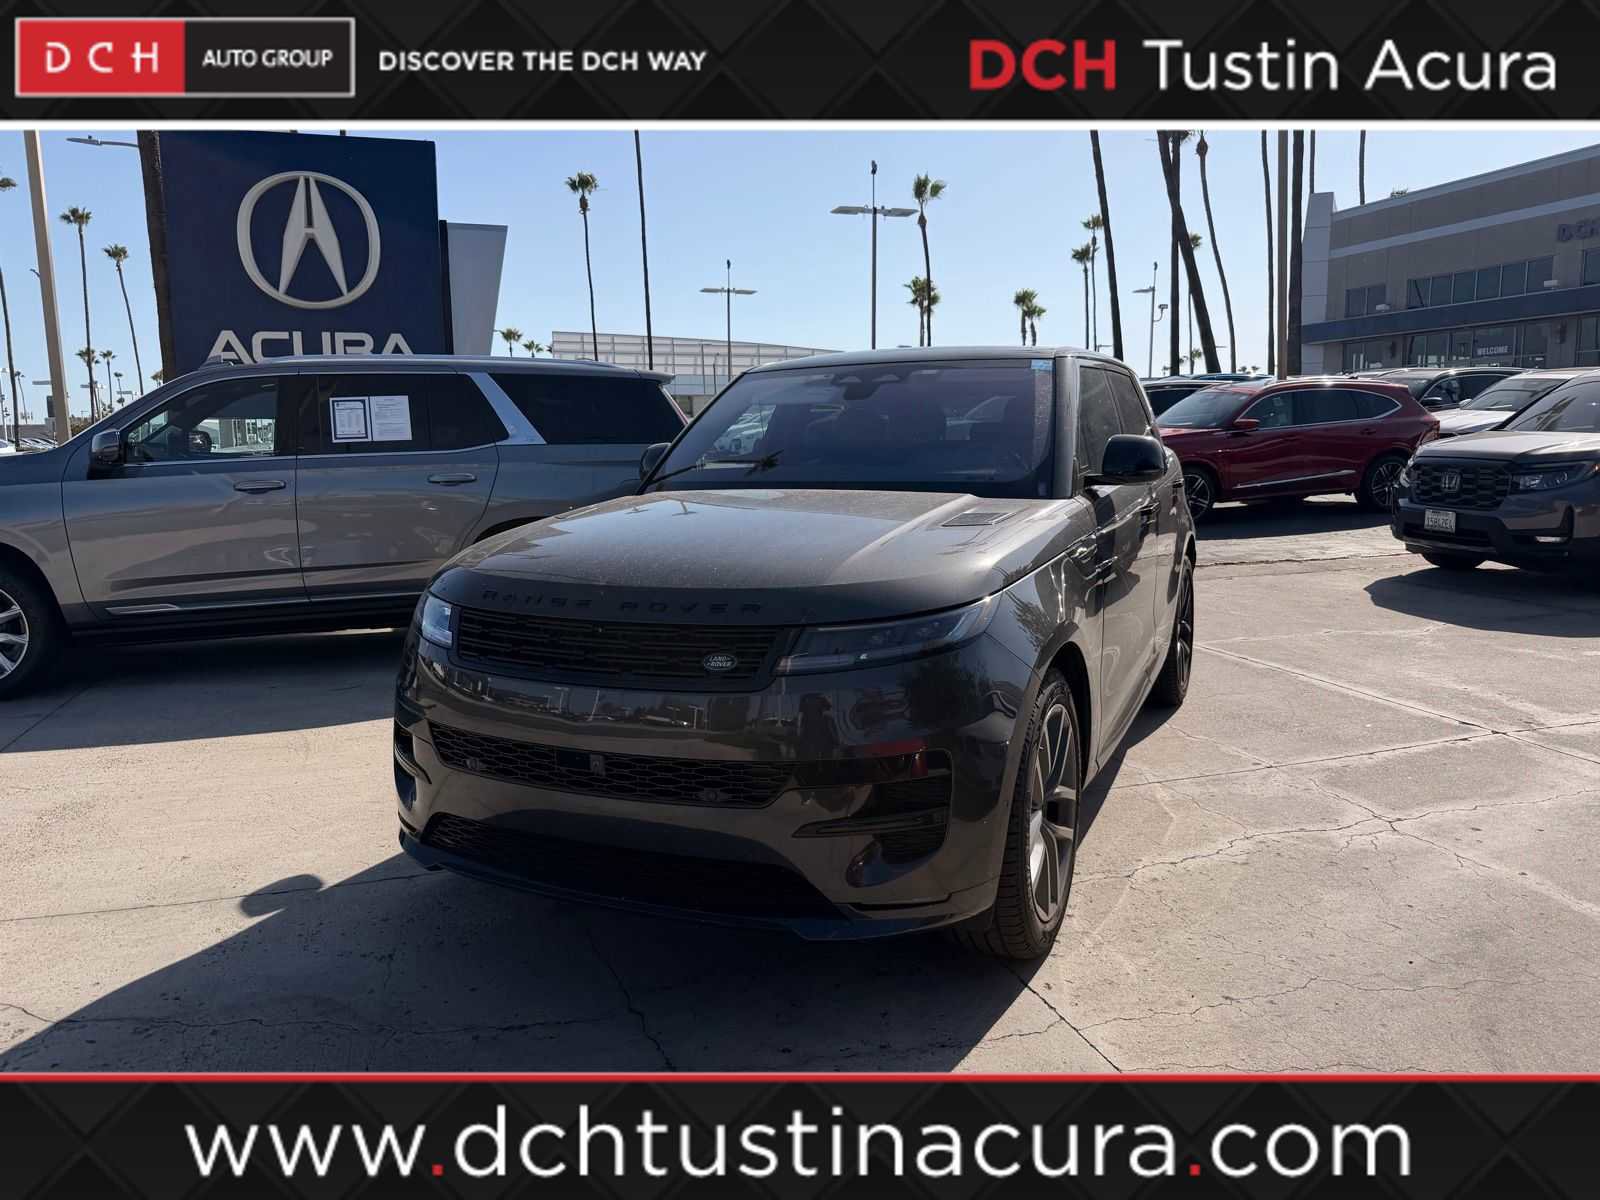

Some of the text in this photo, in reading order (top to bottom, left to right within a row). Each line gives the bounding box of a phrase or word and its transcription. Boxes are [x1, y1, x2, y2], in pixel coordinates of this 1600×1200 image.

[206, 329, 415, 365] ACURA
[1477, 345, 1509, 356] WELCOME
[482, 590, 761, 615] RANGE ROVER
